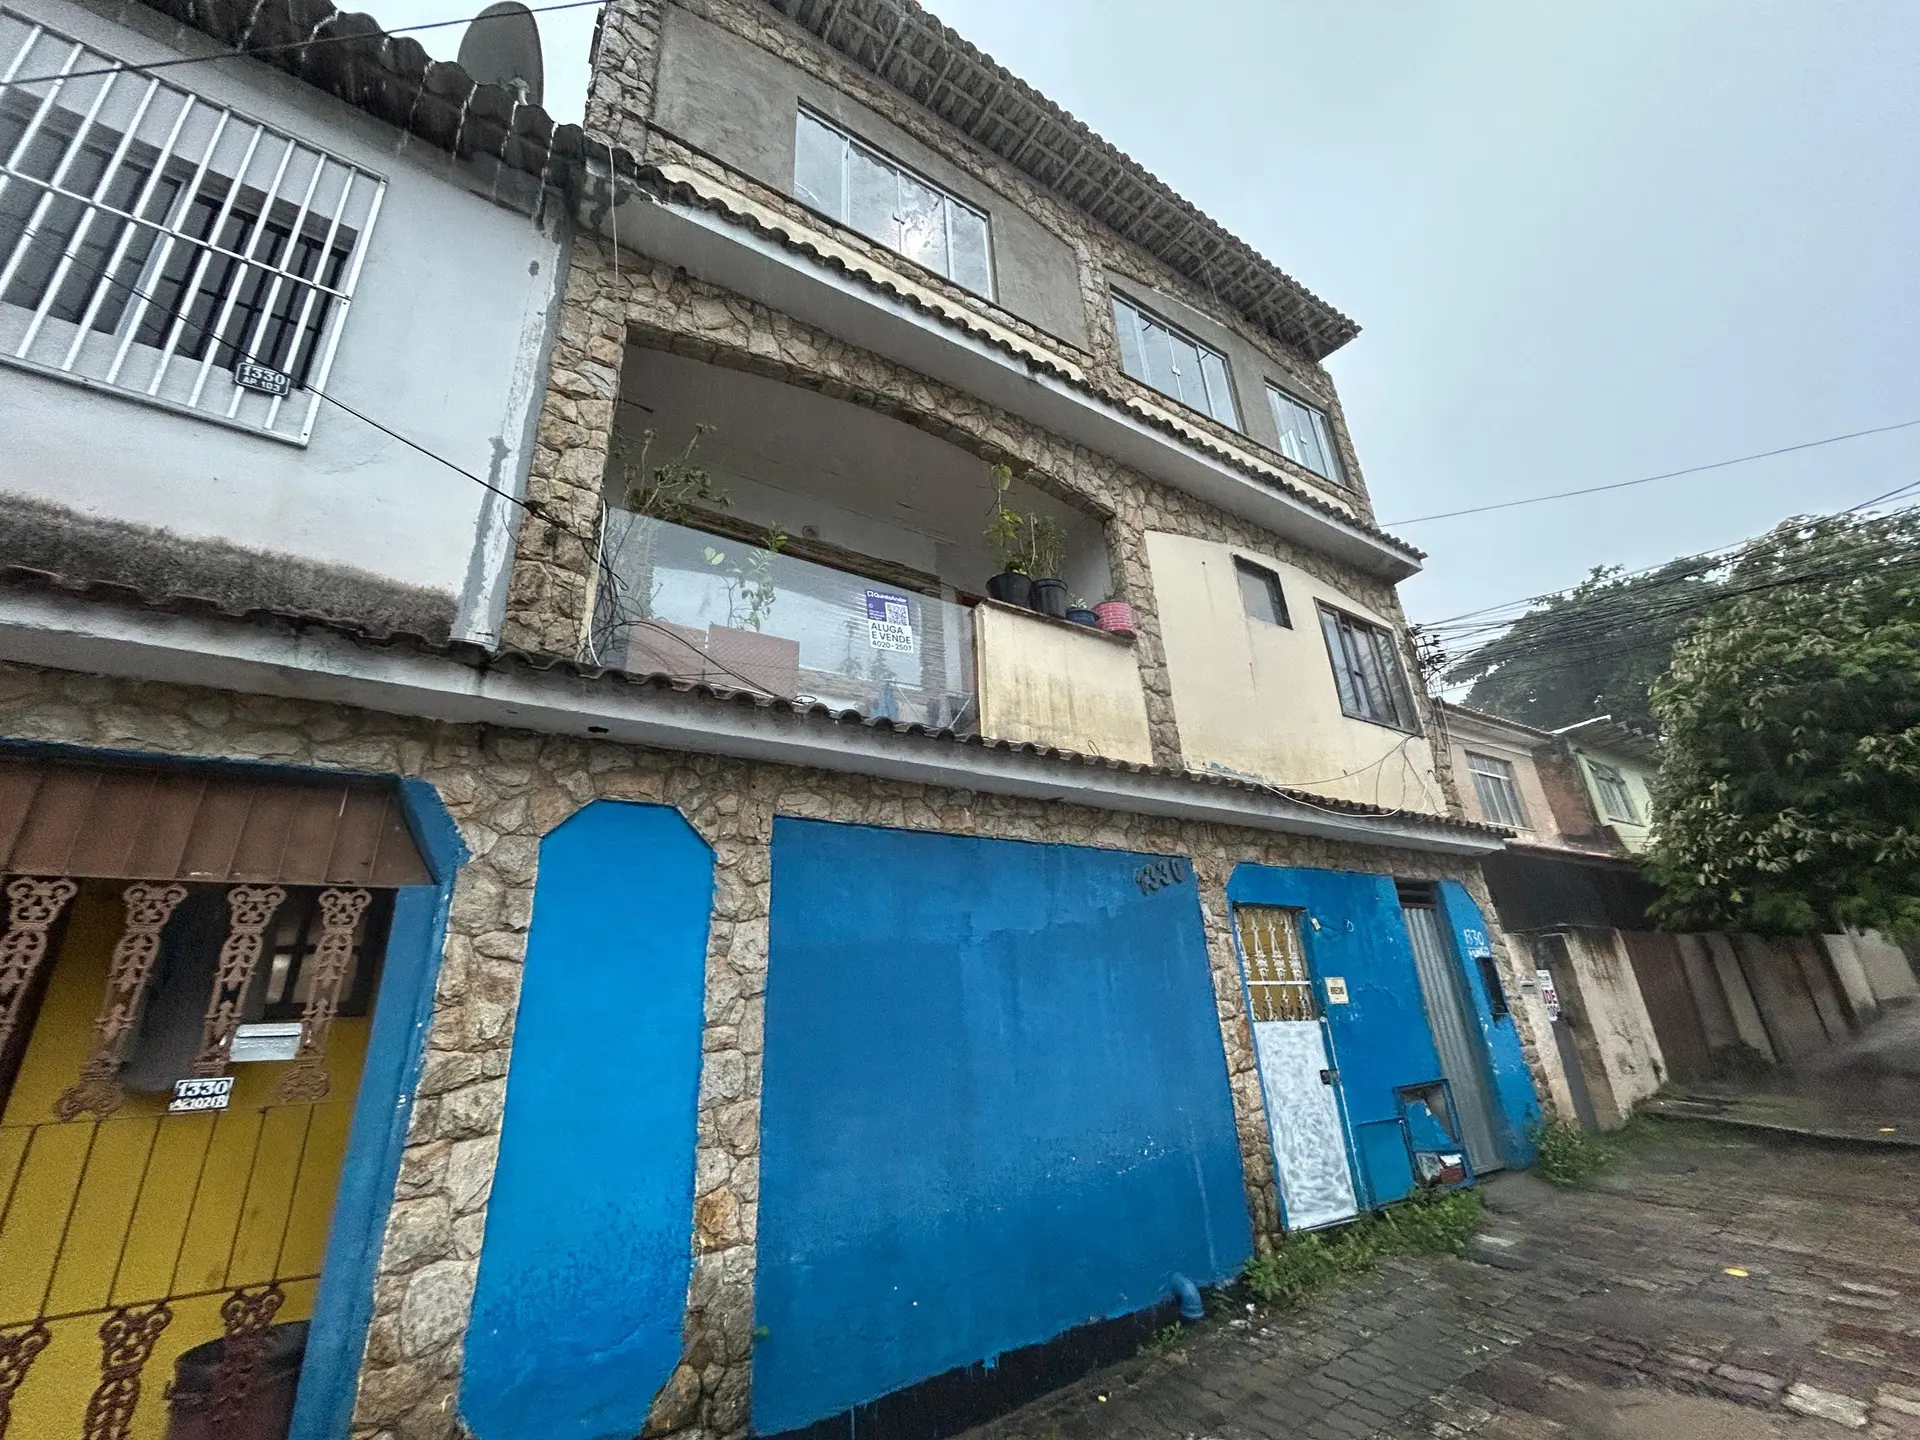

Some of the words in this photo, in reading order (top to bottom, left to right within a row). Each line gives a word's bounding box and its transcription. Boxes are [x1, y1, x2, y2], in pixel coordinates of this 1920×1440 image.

[243, 365, 286, 385] 1330
[871, 622, 904, 635] ALUGA
[871, 631, 878, 640] E
[880, 632, 912, 645] VENDE
[872, 640, 912, 652] 4020-2507
[178, 1080, 229, 1097] 1330
